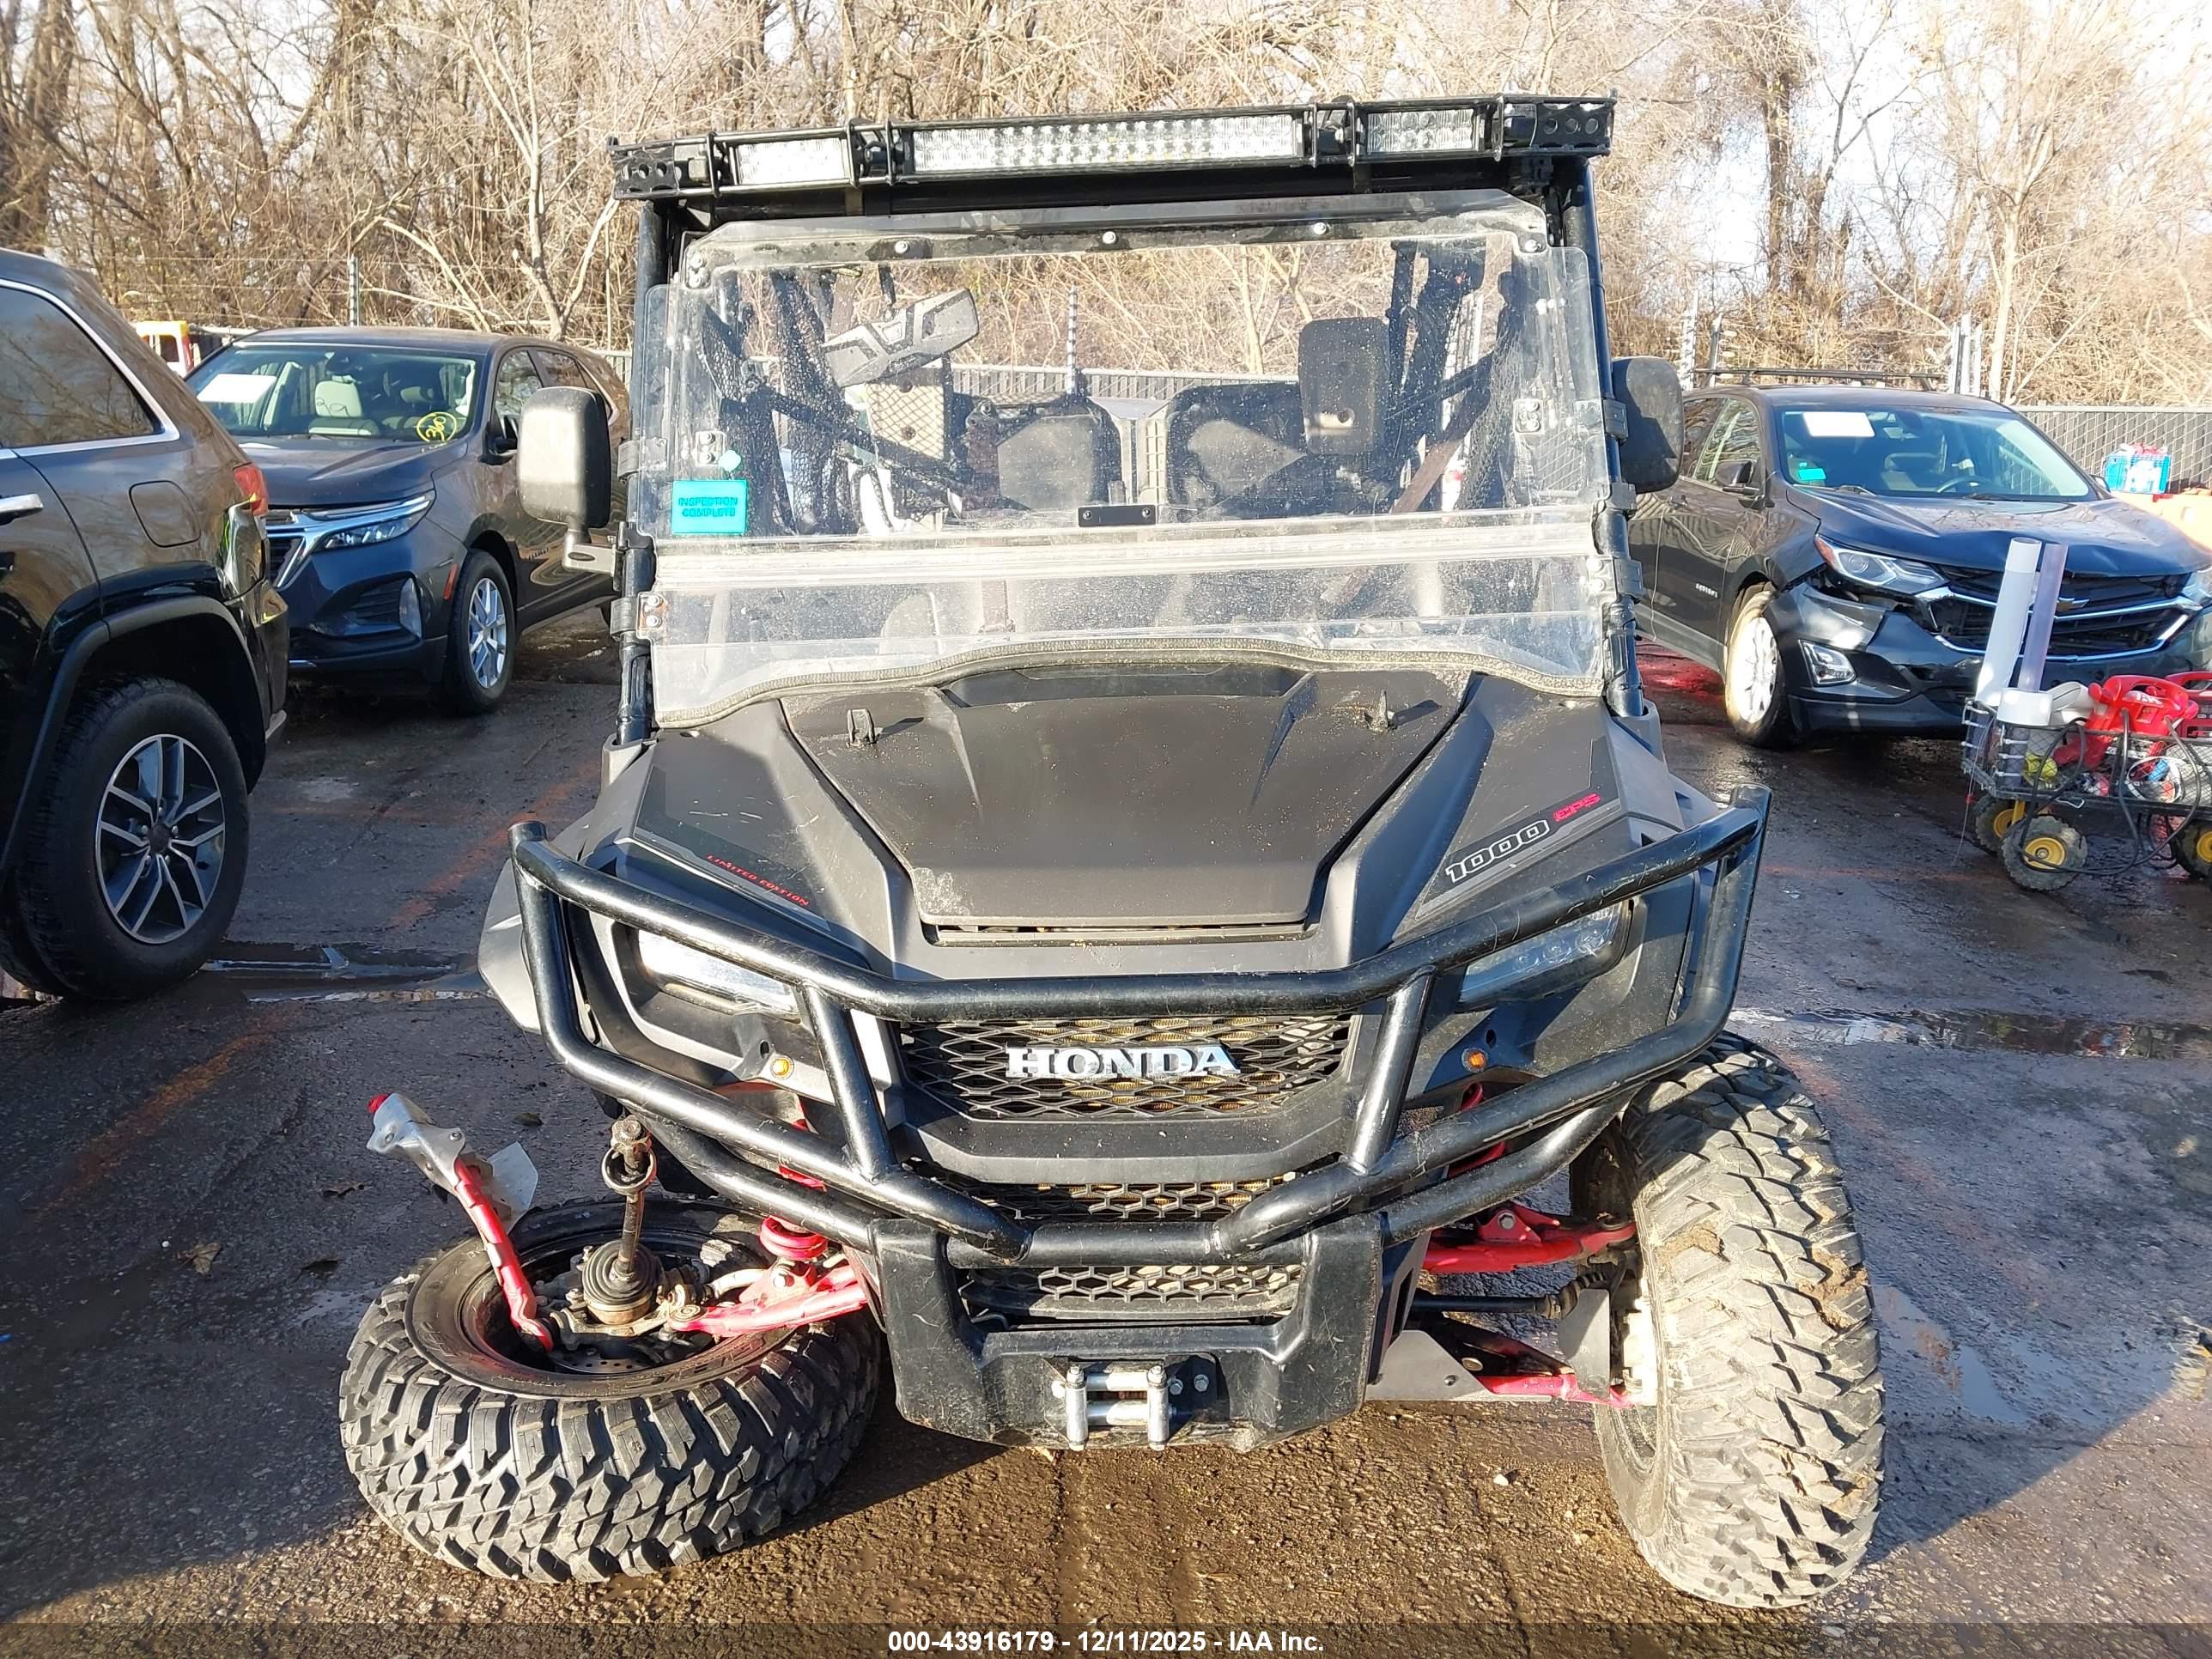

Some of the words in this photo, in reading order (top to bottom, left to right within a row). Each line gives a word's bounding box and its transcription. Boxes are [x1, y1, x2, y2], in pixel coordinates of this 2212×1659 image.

[678, 496, 738, 507] INSPECTION
[682, 507, 737, 518] COMPLETE
[1445, 818, 1550, 884] 1000
[1553, 793, 1601, 823] EPS
[706, 854, 758, 881] LIMITED
[759, 878, 811, 907] EDITION
[1005, 1044, 1242, 1079] HONDA
